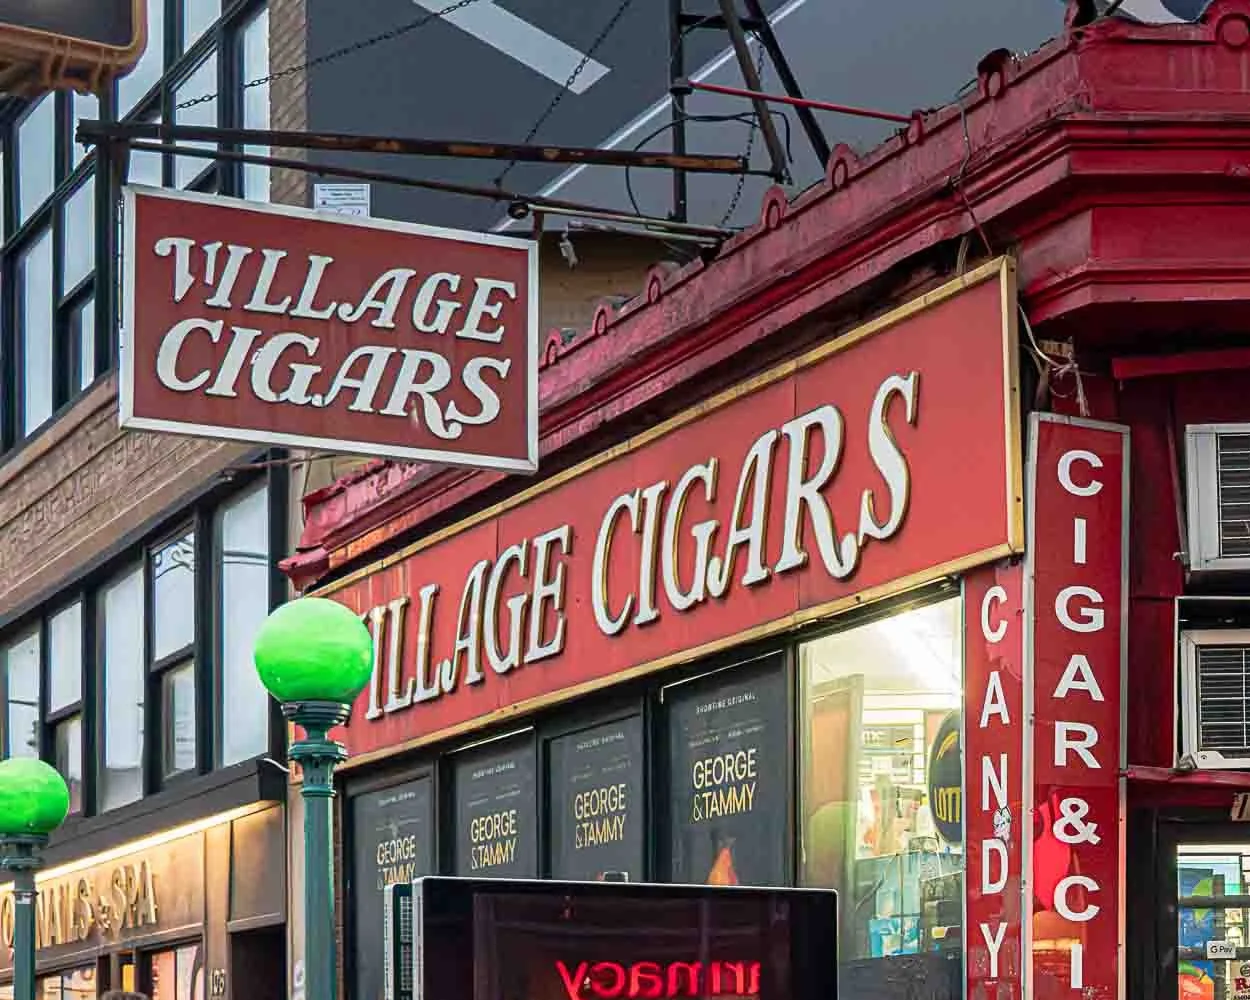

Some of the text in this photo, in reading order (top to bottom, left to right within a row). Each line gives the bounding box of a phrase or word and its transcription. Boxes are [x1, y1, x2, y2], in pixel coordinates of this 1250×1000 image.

[154, 237, 517, 343] VILLAGE
[156, 317, 511, 440] CIGARS
[361, 371, 920, 720] ILLAGE CIGARS
[575, 784, 626, 820] GEORGE
[692, 748, 757, 794] GEORGE
[979, 586, 1010, 978] CANDY
[377, 835, 416, 865] GEORGE
[471, 810, 517, 842] GEORGE
[36, 878, 96, 950] NAILS
[111, 859, 159, 943] SPA
